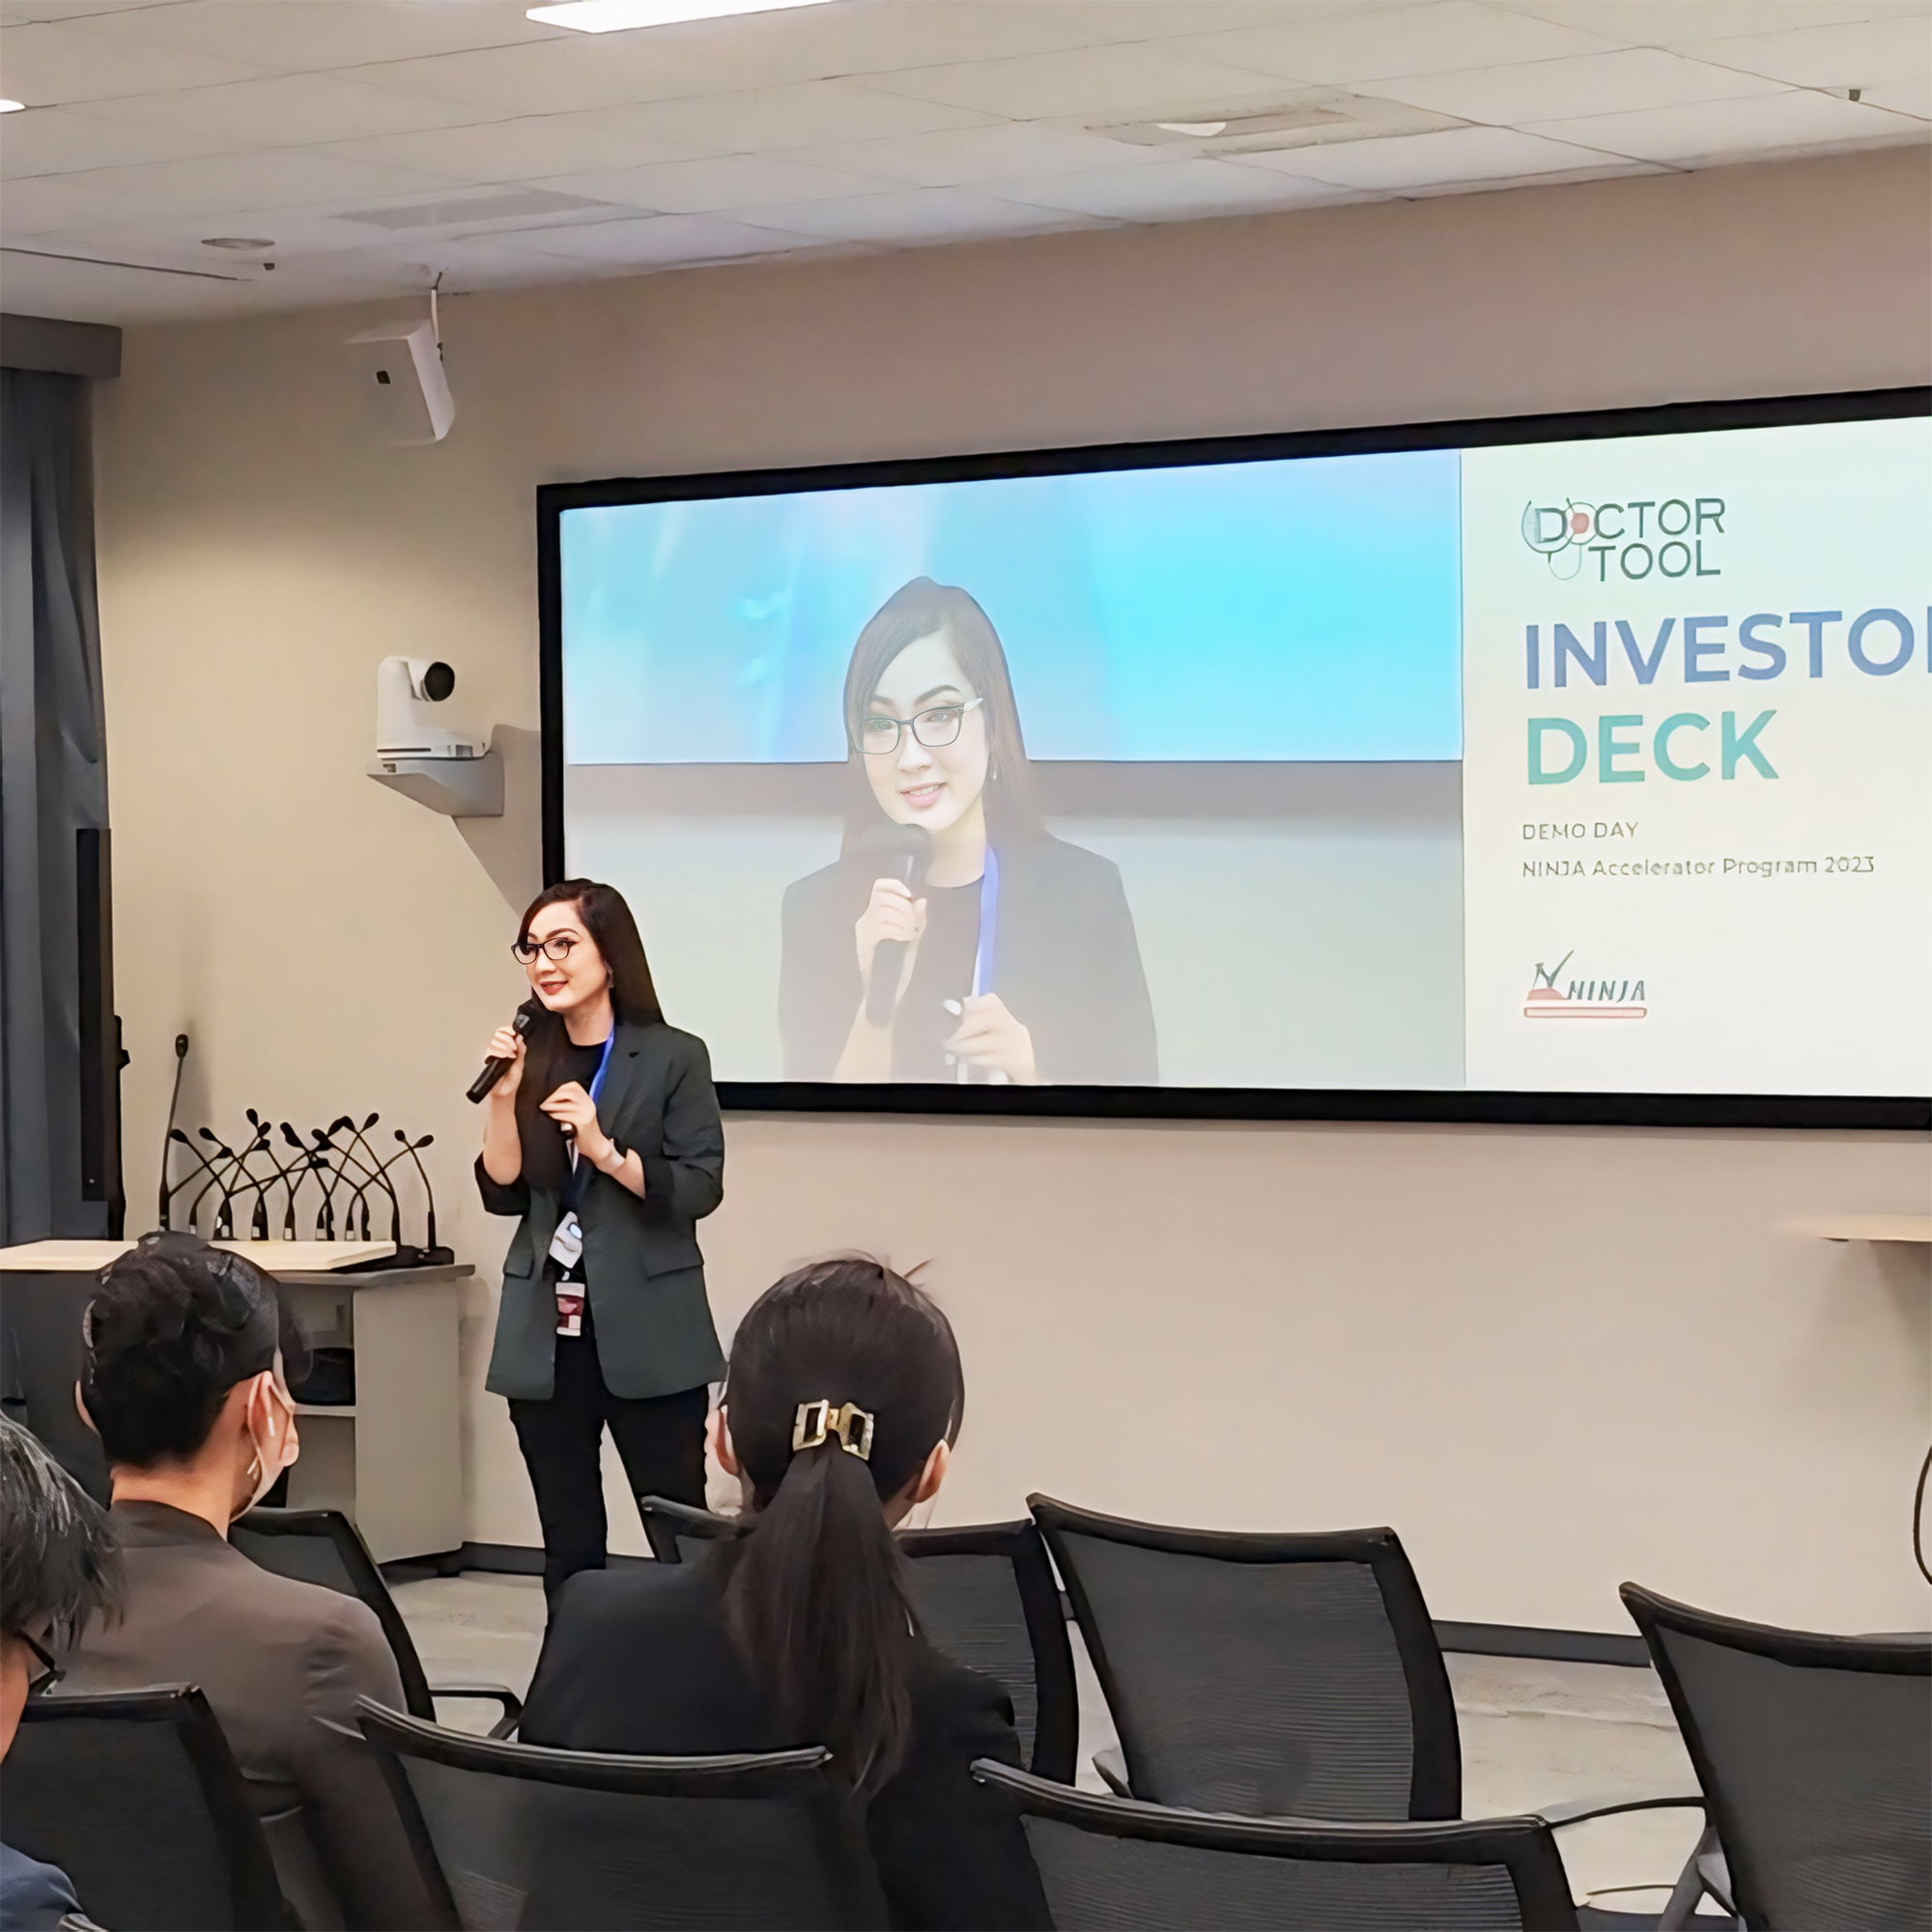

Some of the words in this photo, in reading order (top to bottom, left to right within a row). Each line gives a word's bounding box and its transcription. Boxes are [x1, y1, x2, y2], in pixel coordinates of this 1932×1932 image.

[1588, 539, 1721, 582] TOOL
[1525, 606, 1932, 689] INVESTO
[1527, 709, 1780, 785] DECK
[1522, 822, 1586, 839] DEMO
[1594, 821, 1639, 838] DAY
[1522, 860, 1585, 877] NINJA
[1592, 858, 1715, 876] Accelerator
[1723, 857, 1818, 878] Program
[1825, 855, 1875, 873] 2023
[1567, 980, 1646, 1004] NINJA
